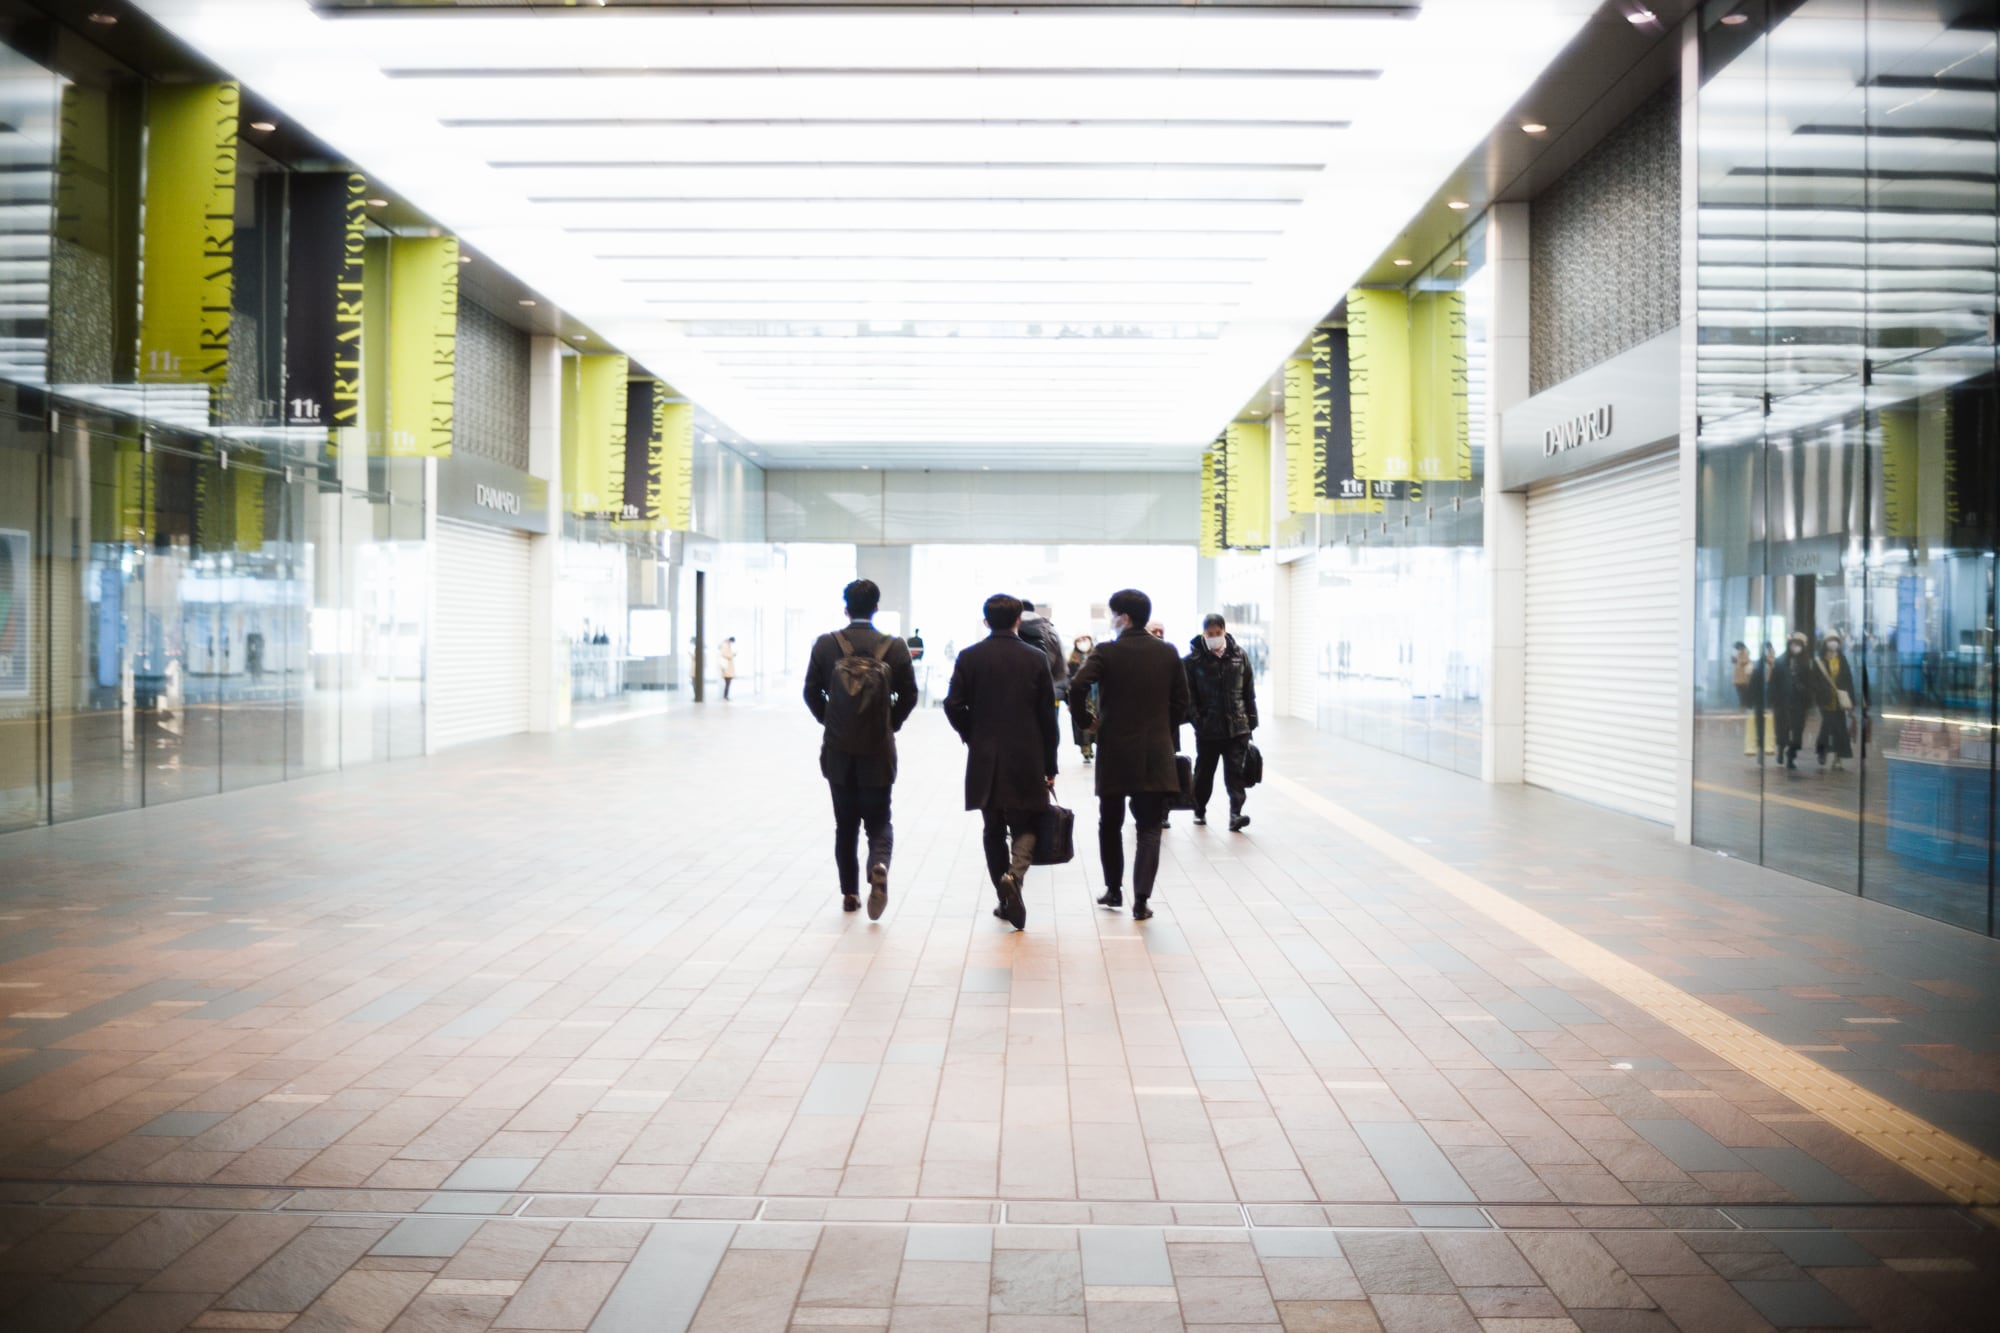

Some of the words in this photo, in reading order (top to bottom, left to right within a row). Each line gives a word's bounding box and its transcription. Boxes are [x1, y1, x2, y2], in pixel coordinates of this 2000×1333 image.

[213, 84, 239, 196] TOKYO
[344, 173, 367, 270] TOKYO
[440, 238, 458, 319] TOKYO
[1313, 434, 1328, 498] TOKYO
[1350, 405, 1368, 479] TOKYO
[1543, 404, 1612, 457] DAIMARU
[476, 484, 520, 515] DAIMARU
